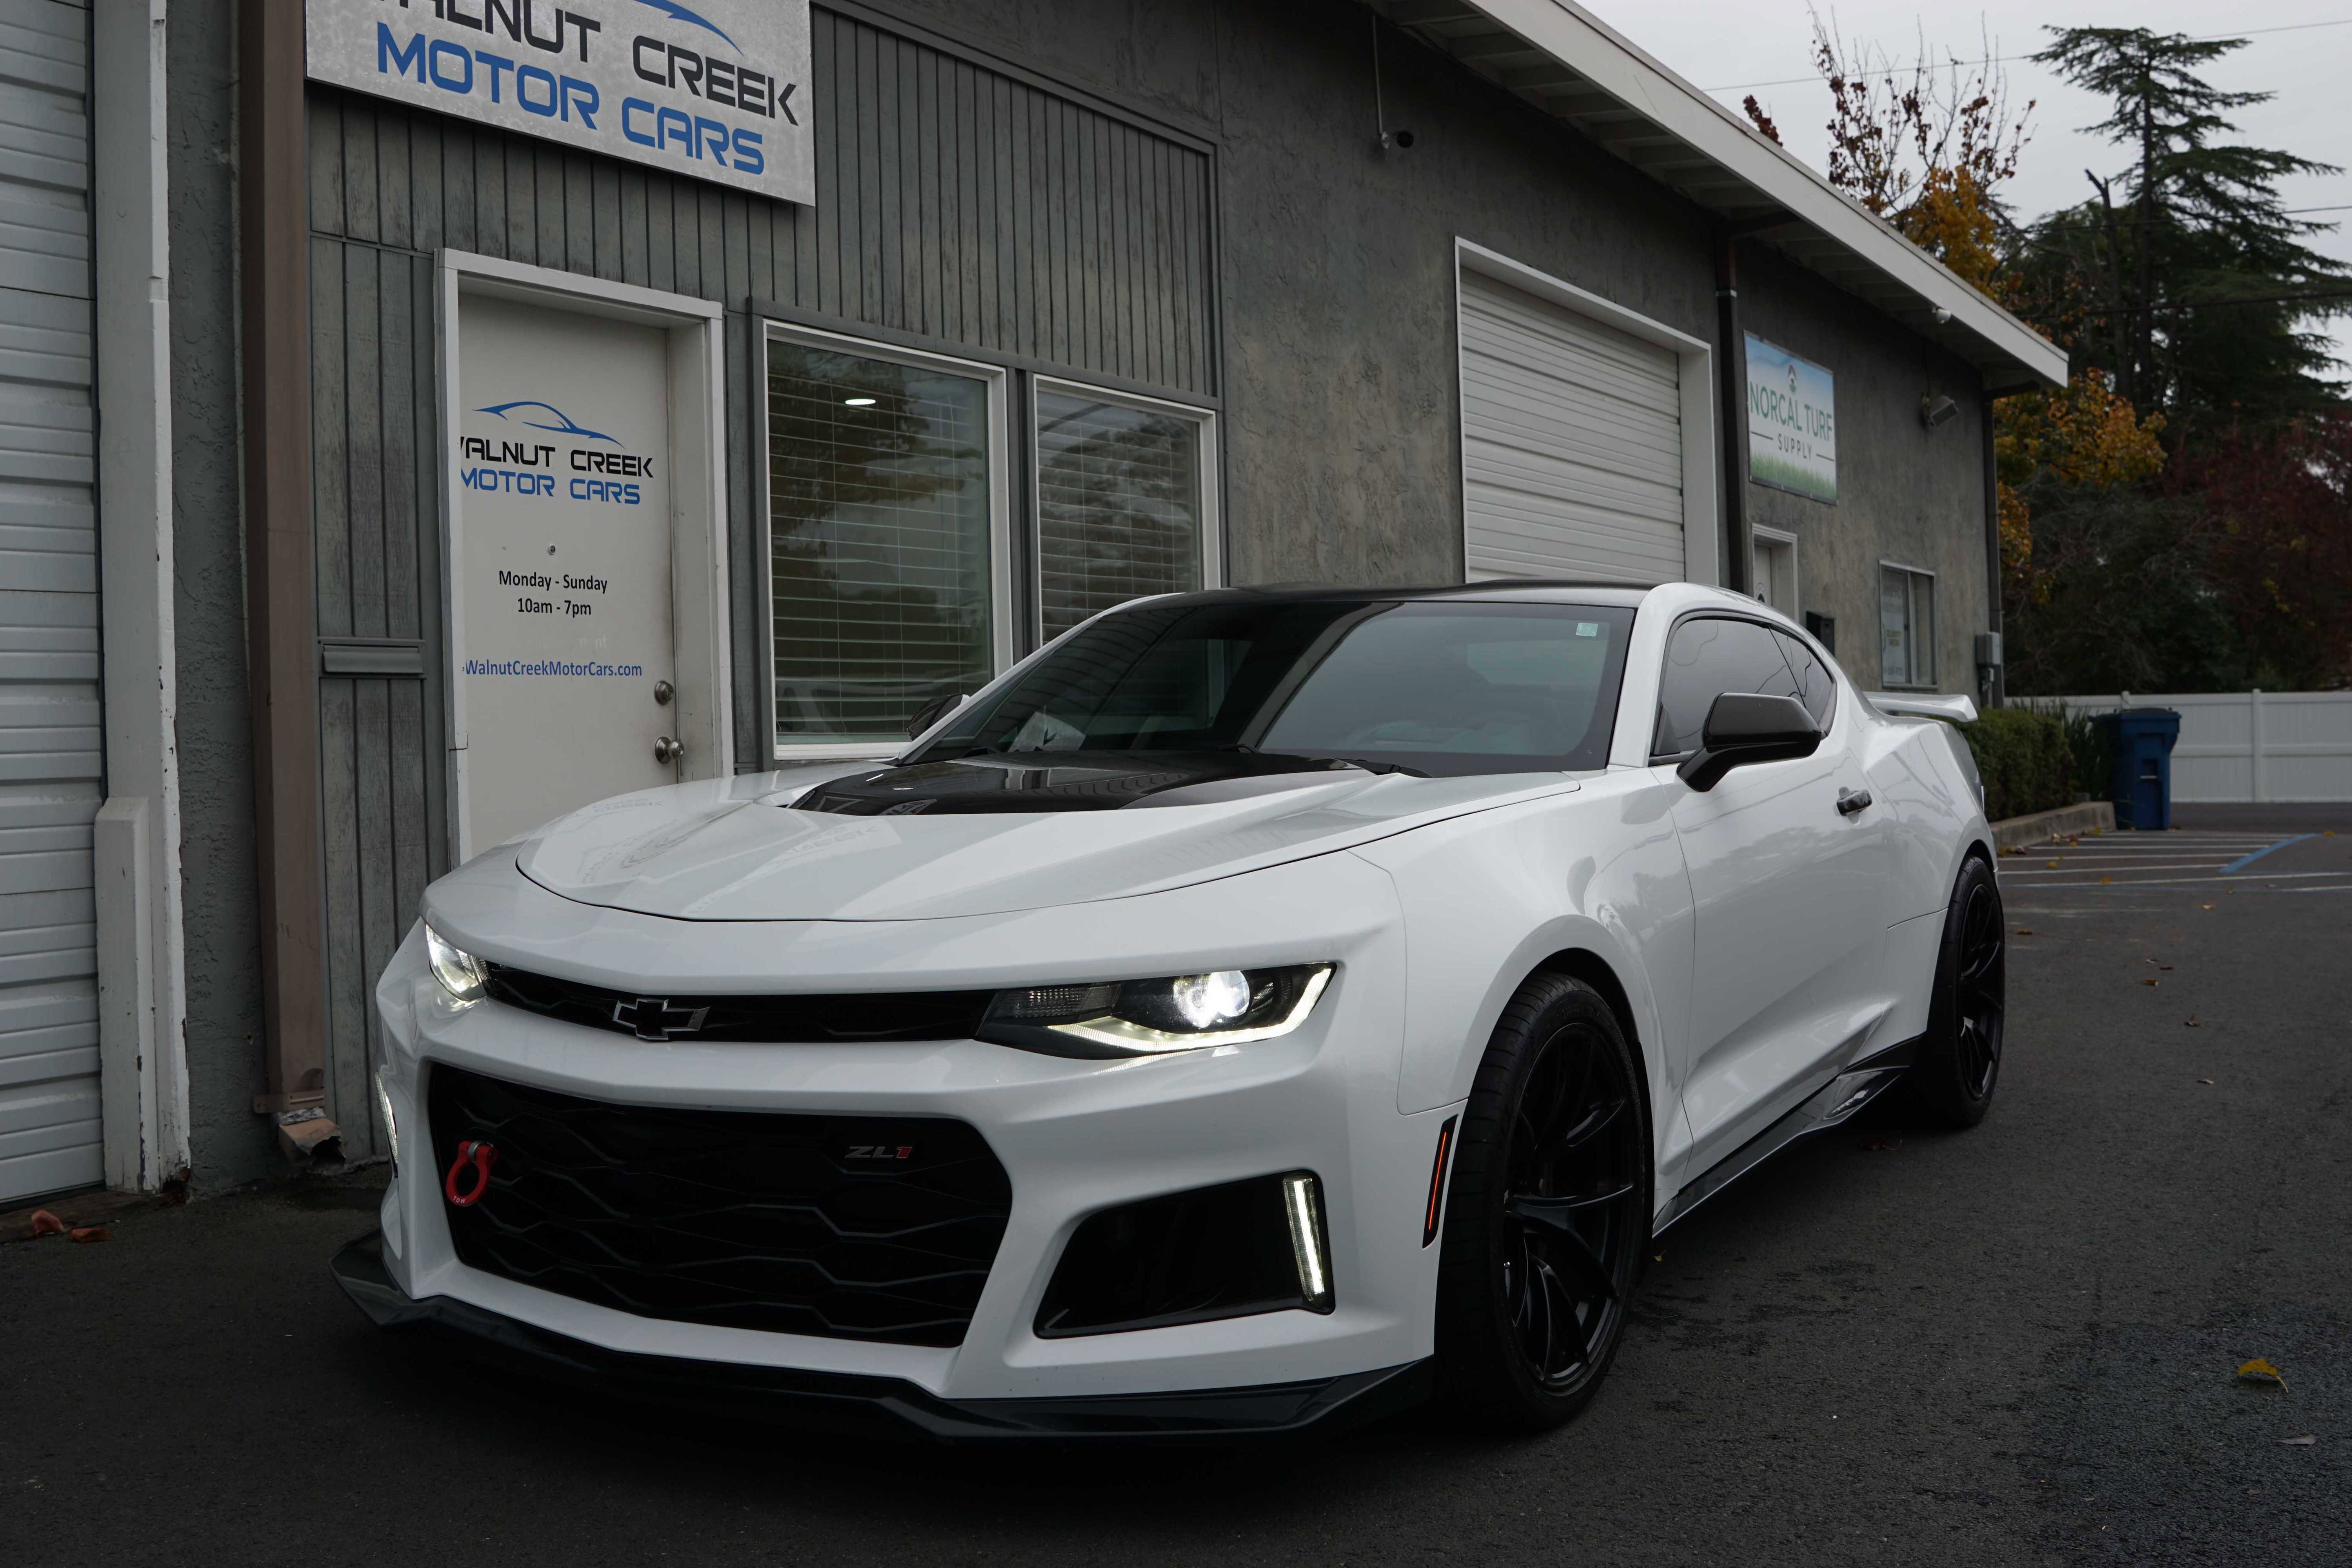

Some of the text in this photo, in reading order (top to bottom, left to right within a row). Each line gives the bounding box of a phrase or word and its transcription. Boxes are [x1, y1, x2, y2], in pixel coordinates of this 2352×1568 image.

[633, 35, 798, 127] CREEK
[377, 22, 764, 176] MOTOR CARS
[1750, 381, 1832, 442] NORCAL TURF
[1778, 433, 1812, 460] SUPPLY
[571, 450, 653, 478] CREEK
[461, 468, 640, 505] MOTOR CARS
[499, 570, 552, 591] Monday
[563, 574, 608, 594] Sunday
[518, 598, 552, 614] 10am
[564, 600, 591, 618] 7pm
[466, 659, 642, 676] WalnutCreekMotorCars.com
[844, 1146, 913, 1159] ZL1
[453, 1195, 466, 1204] TOW
